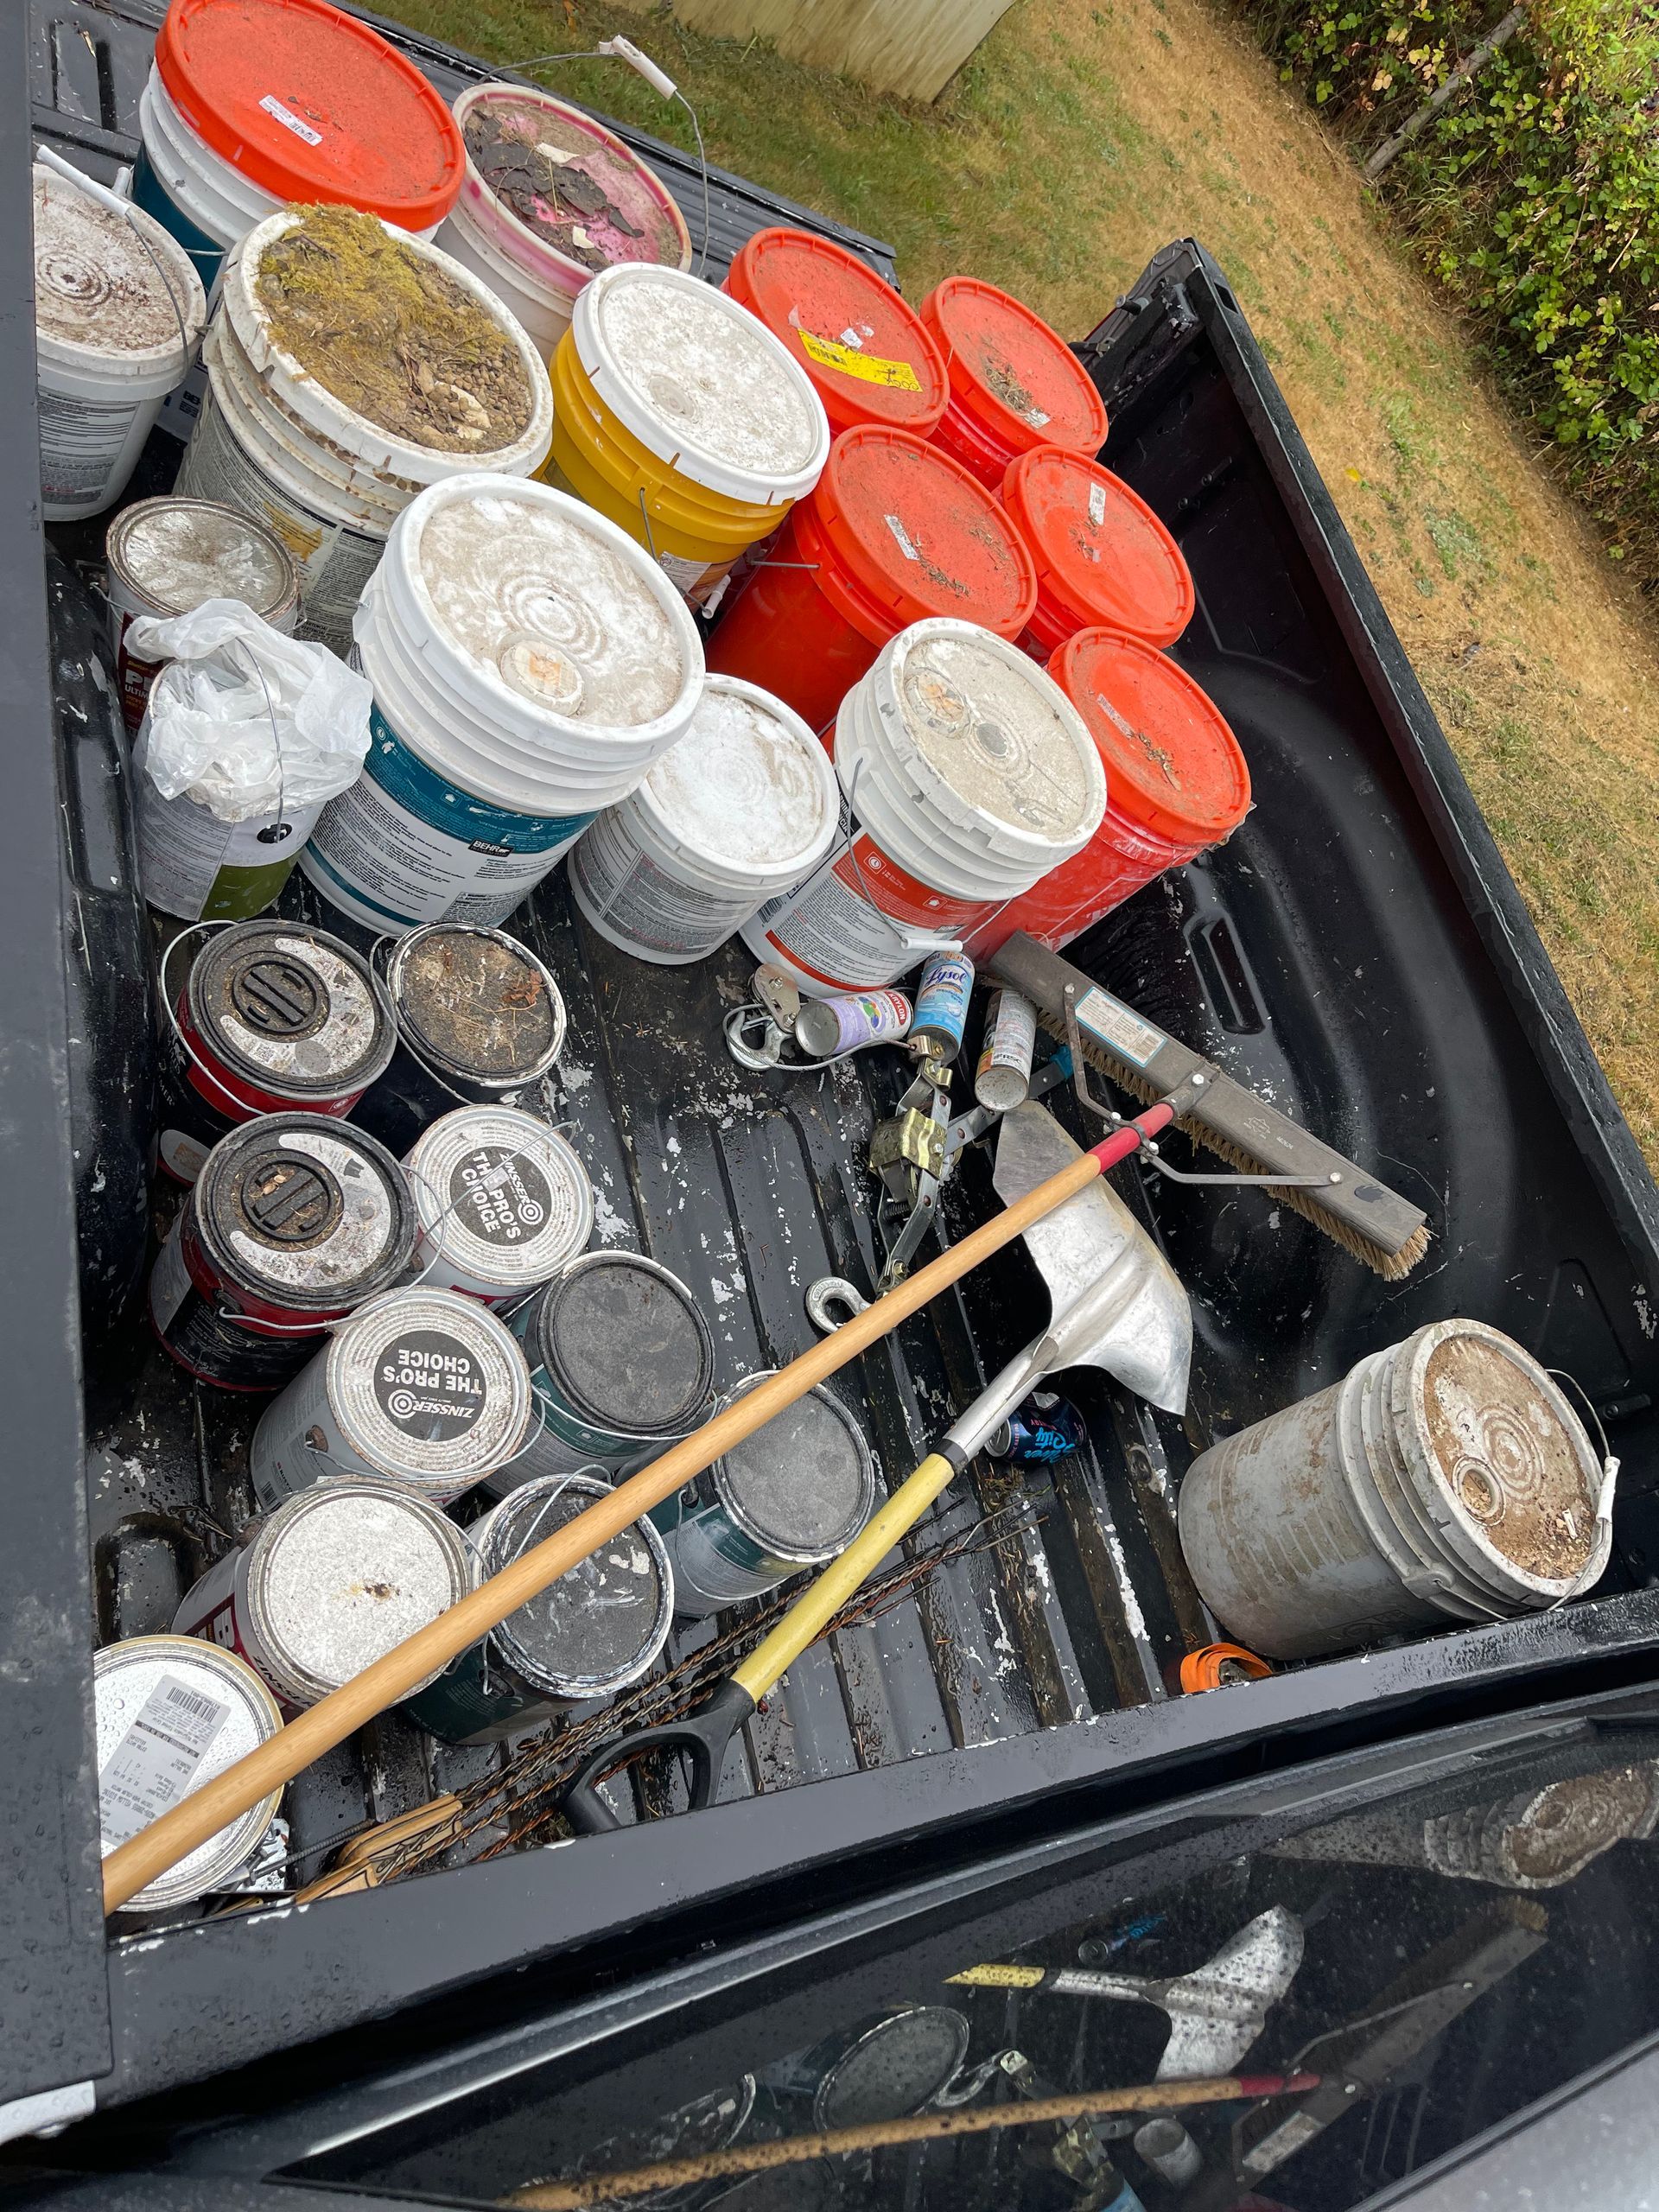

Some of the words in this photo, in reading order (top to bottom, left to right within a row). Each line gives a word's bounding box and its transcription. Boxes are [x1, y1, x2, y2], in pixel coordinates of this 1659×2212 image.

[473, 840, 501, 853] BEHR
[925, 967, 967, 988] Lysol
[888, 993, 906, 1020] KRYLON
[499, 1153, 531, 1205] ZINSSER
[461, 1168, 501, 1233] CHOICE
[489, 1188, 521, 1239] PRO'S
[397, 1349, 471, 1374] CHOICE
[383, 1365, 440, 1389] PRO'S
[445, 1374, 483, 1395] THE
[412, 1401, 475, 1418] ZINSSER
[1035, 1427, 1066, 1449] City
